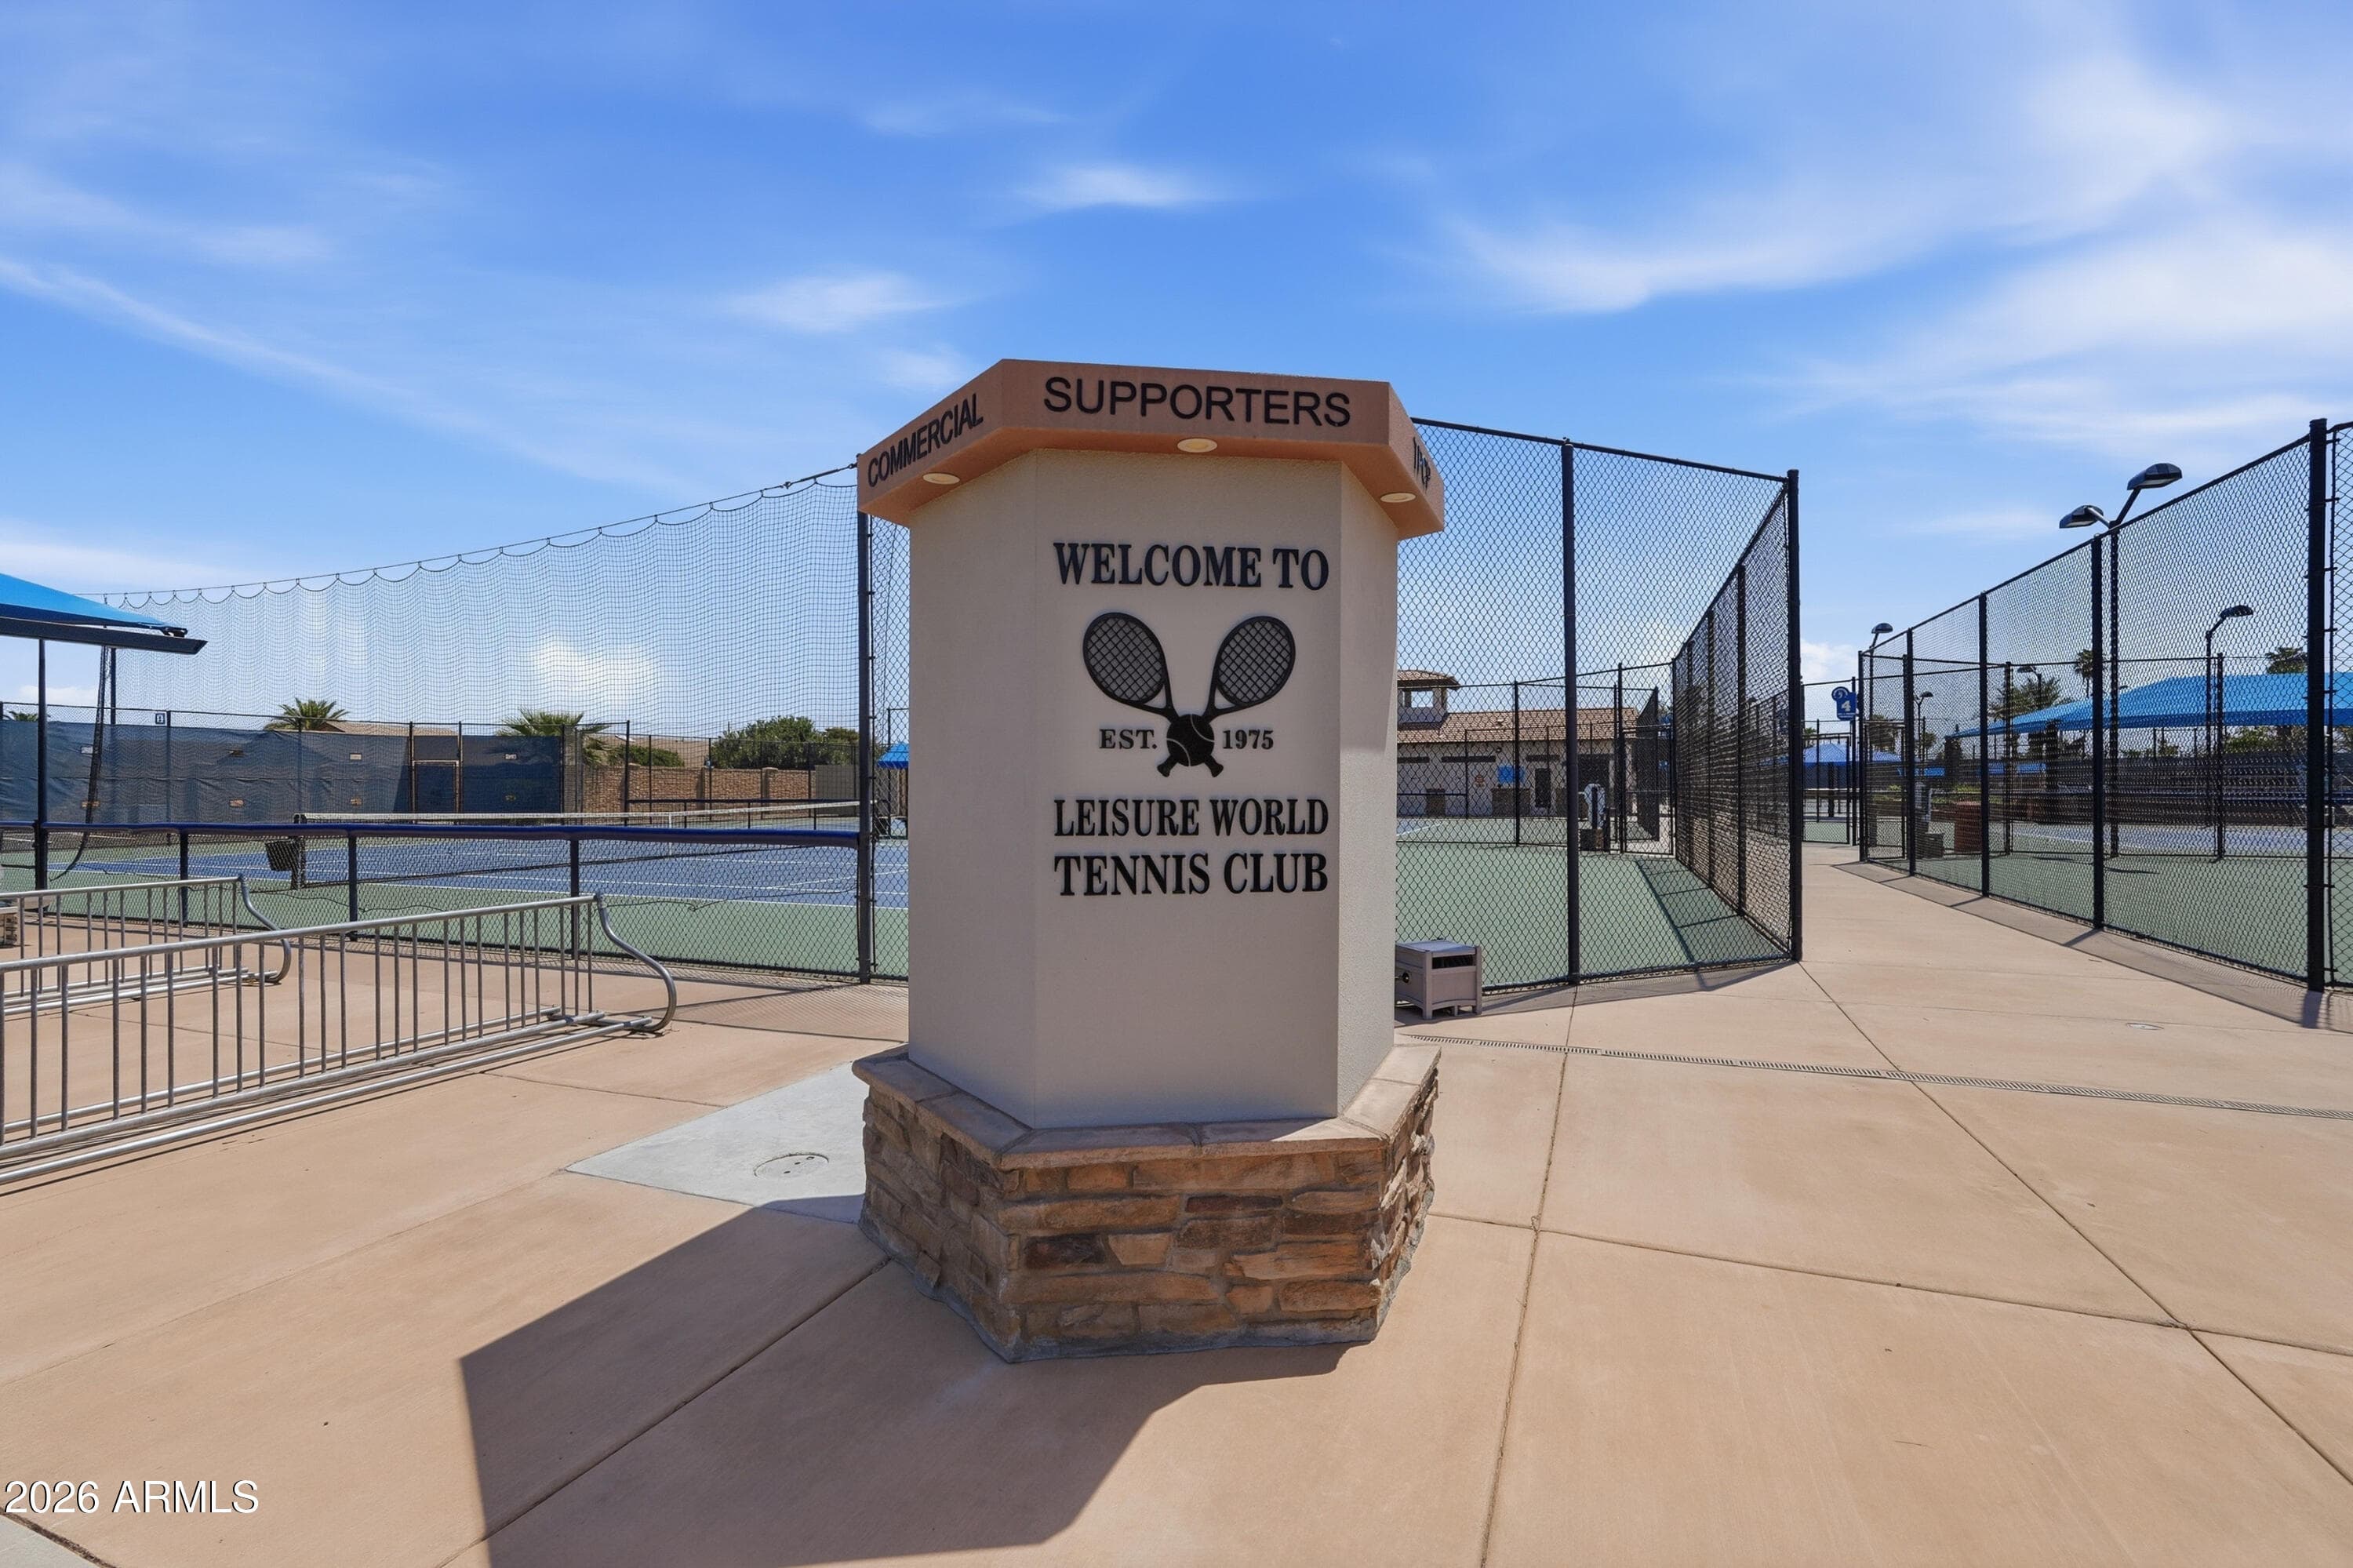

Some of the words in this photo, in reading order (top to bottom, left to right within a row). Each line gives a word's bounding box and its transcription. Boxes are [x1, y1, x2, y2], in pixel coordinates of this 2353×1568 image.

[1044, 377, 1351, 427] SUPPORTERS
[867, 393, 984, 487] COMMERCIAL
[1053, 542, 1262, 587] WELCOME
[1273, 548, 1329, 591] TO
[1841, 700, 1851, 712] 4
[1100, 729, 1157, 749] EST.
[1223, 729, 1274, 749] 1975
[1054, 799, 1199, 836] LEISURE
[1209, 799, 1329, 836] WORLD
[1054, 853, 1210, 896] TENNIS
[1224, 852, 1328, 894] CLUB
